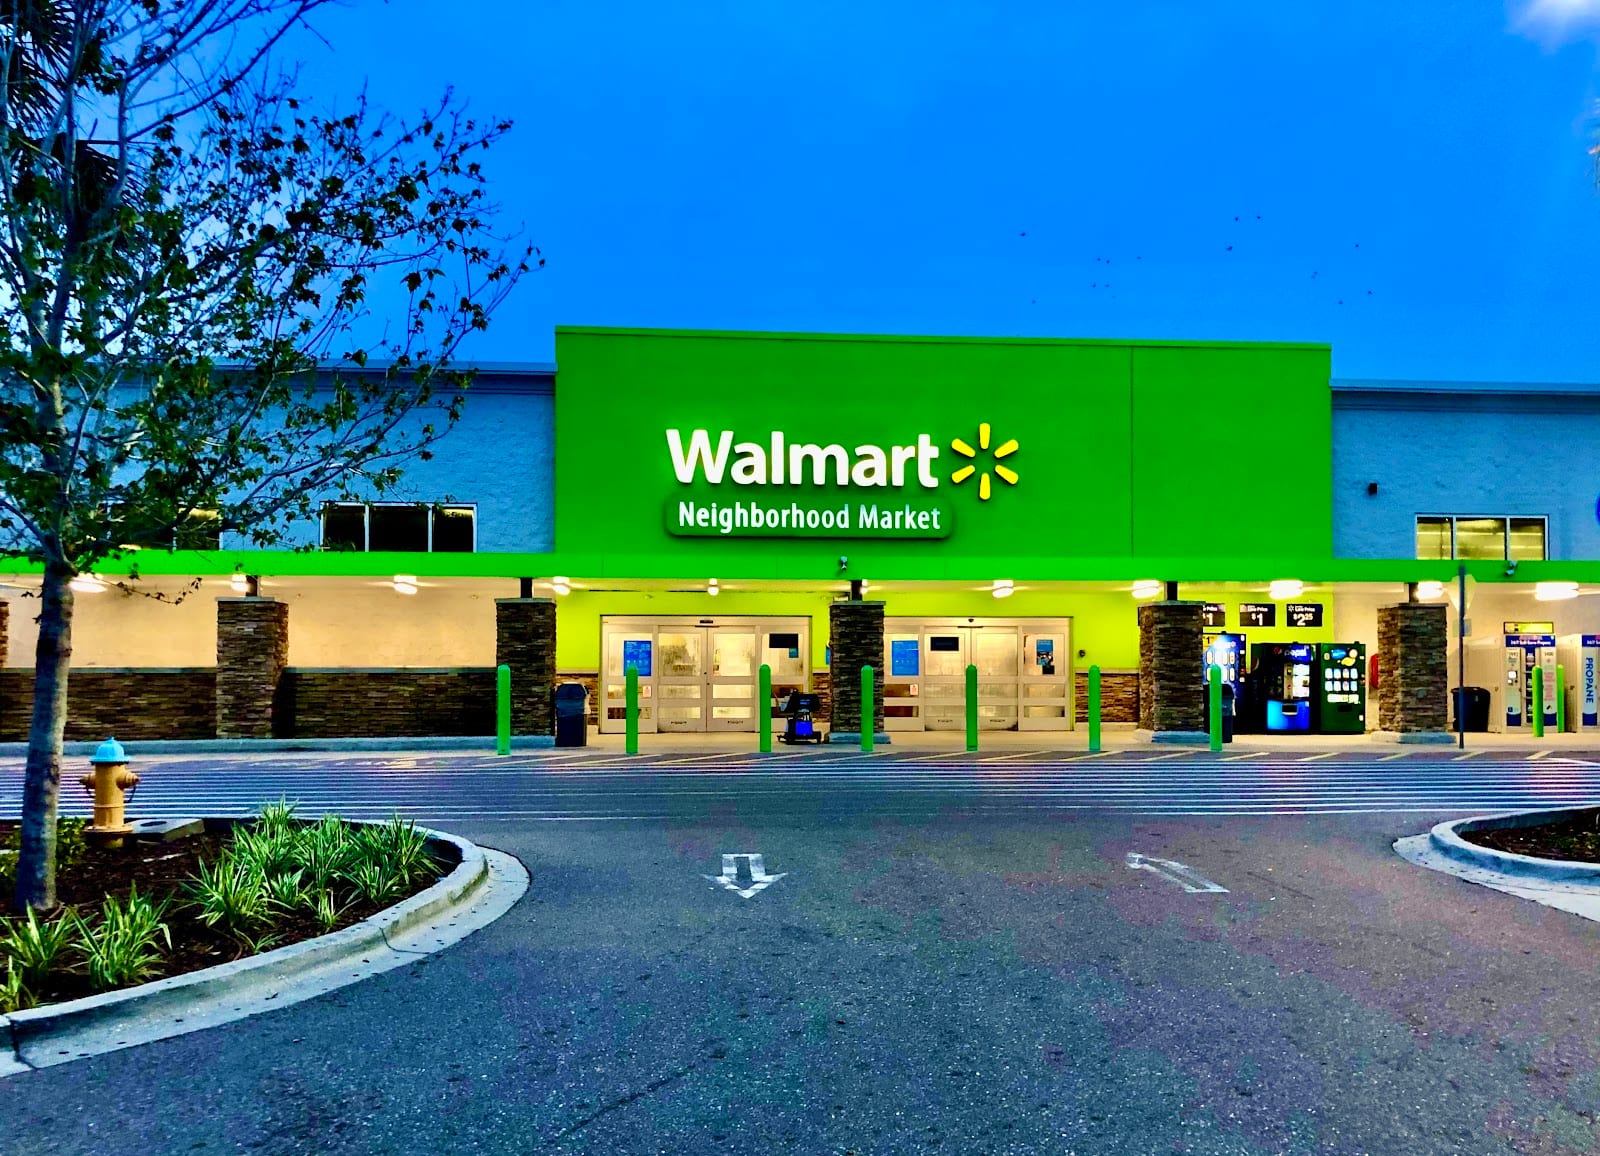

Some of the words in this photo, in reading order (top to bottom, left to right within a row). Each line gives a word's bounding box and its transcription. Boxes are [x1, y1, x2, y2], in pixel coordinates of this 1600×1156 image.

[666, 429, 939, 487] Walmart
[678, 501, 849, 533] Neighborhood
[859, 504, 940, 529] Market
[1251, 613, 1263, 625] $1
[1585, 657, 1594, 703] PROPANE
